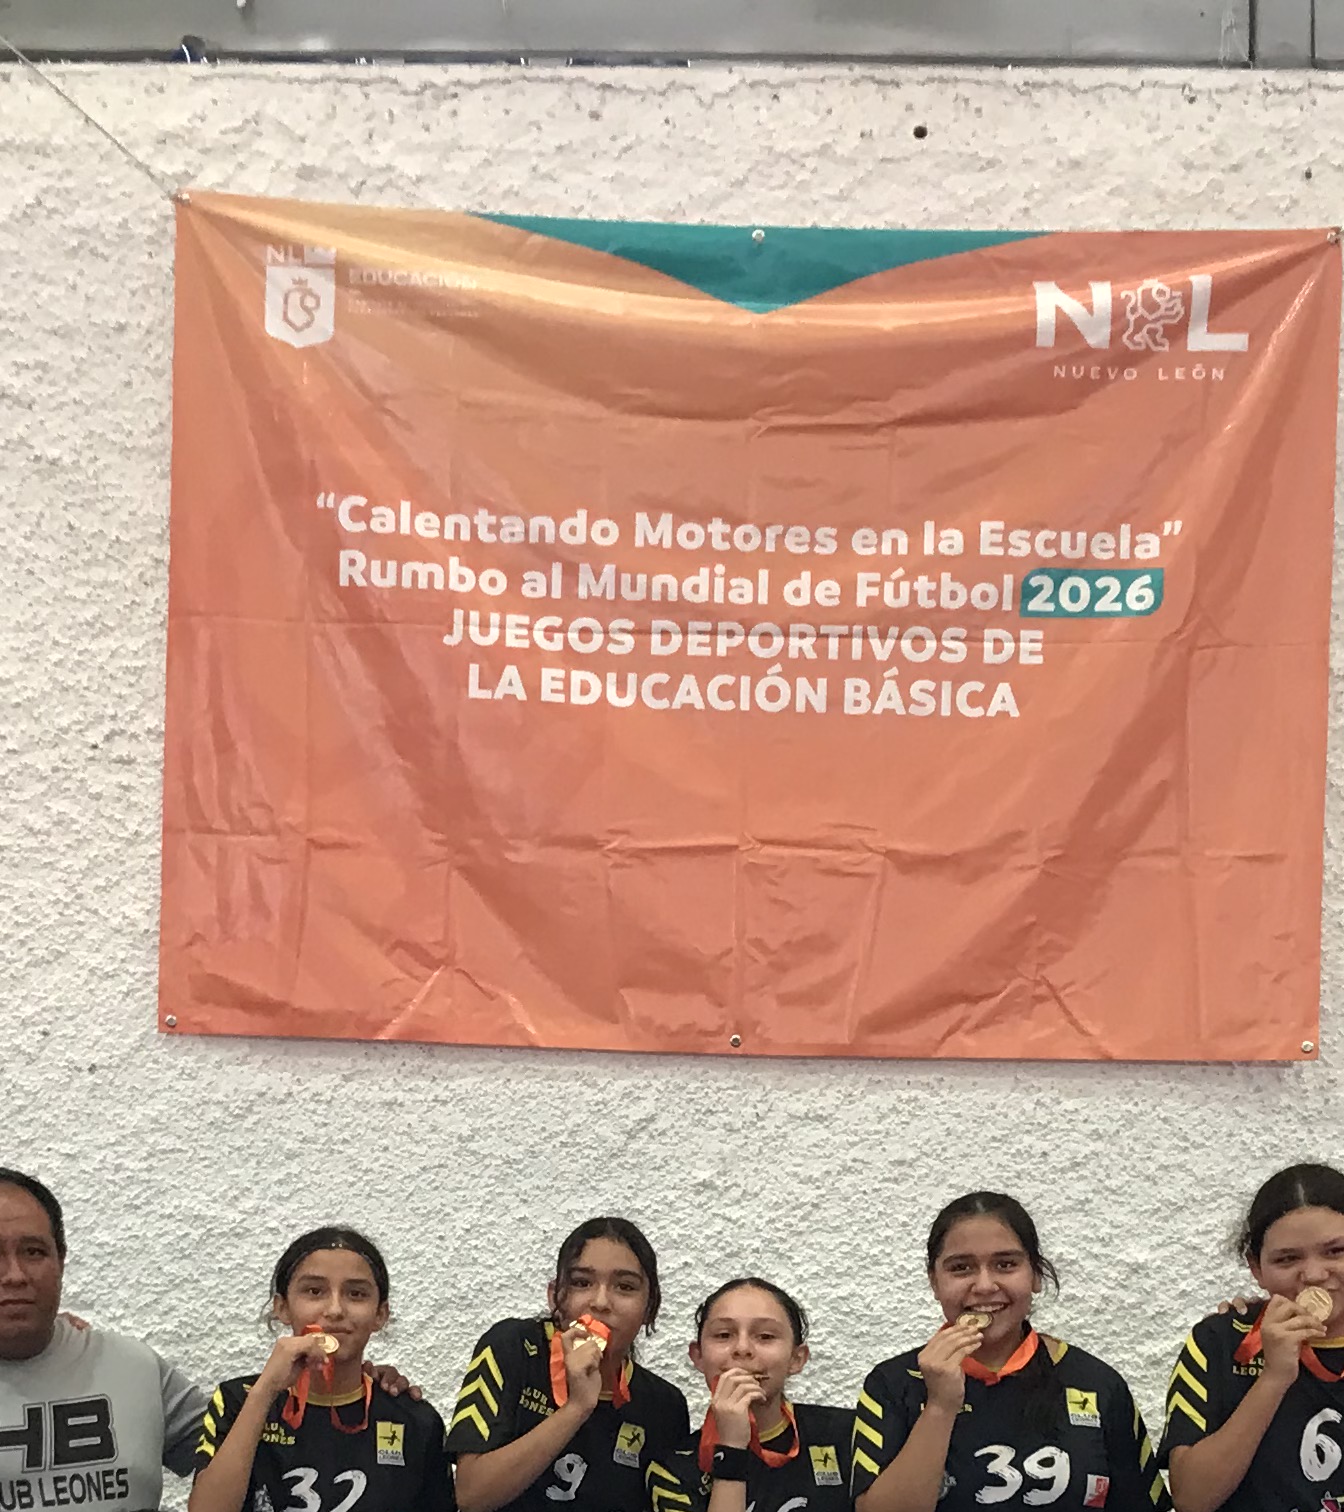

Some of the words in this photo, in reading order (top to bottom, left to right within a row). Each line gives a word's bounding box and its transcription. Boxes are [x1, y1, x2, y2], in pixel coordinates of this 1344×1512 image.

[1053, 365, 1138, 381] NUEVO
[1158, 364, 1225, 381] LEÓN
[634, 512, 838, 555] Motores
[852, 528, 908, 556] en
[923, 520, 964, 556] la
[338, 549, 508, 596] Rumbo
[522, 561, 563, 600] al
[577, 562, 769, 605] Mundial
[783, 570, 841, 607] de
[855, 566, 1014, 612] Fútbol
[1027, 574, 1155, 613] 2026
[443, 608, 636, 656] JUEGOS
[650, 620, 967, 665] DEPORTIVOS
[983, 628, 1044, 665] DE
[468, 664, 527, 701] LA
[540, 662, 828, 714] EDUCACIÓN
[843, 667, 1020, 718] BÁSICA
[1300, 1408, 1342, 1482] 6
[38, 1467, 130, 1508] LEONES
[546, 1453, 588, 1501] 9
[974, 1444, 1071, 1506] 39
